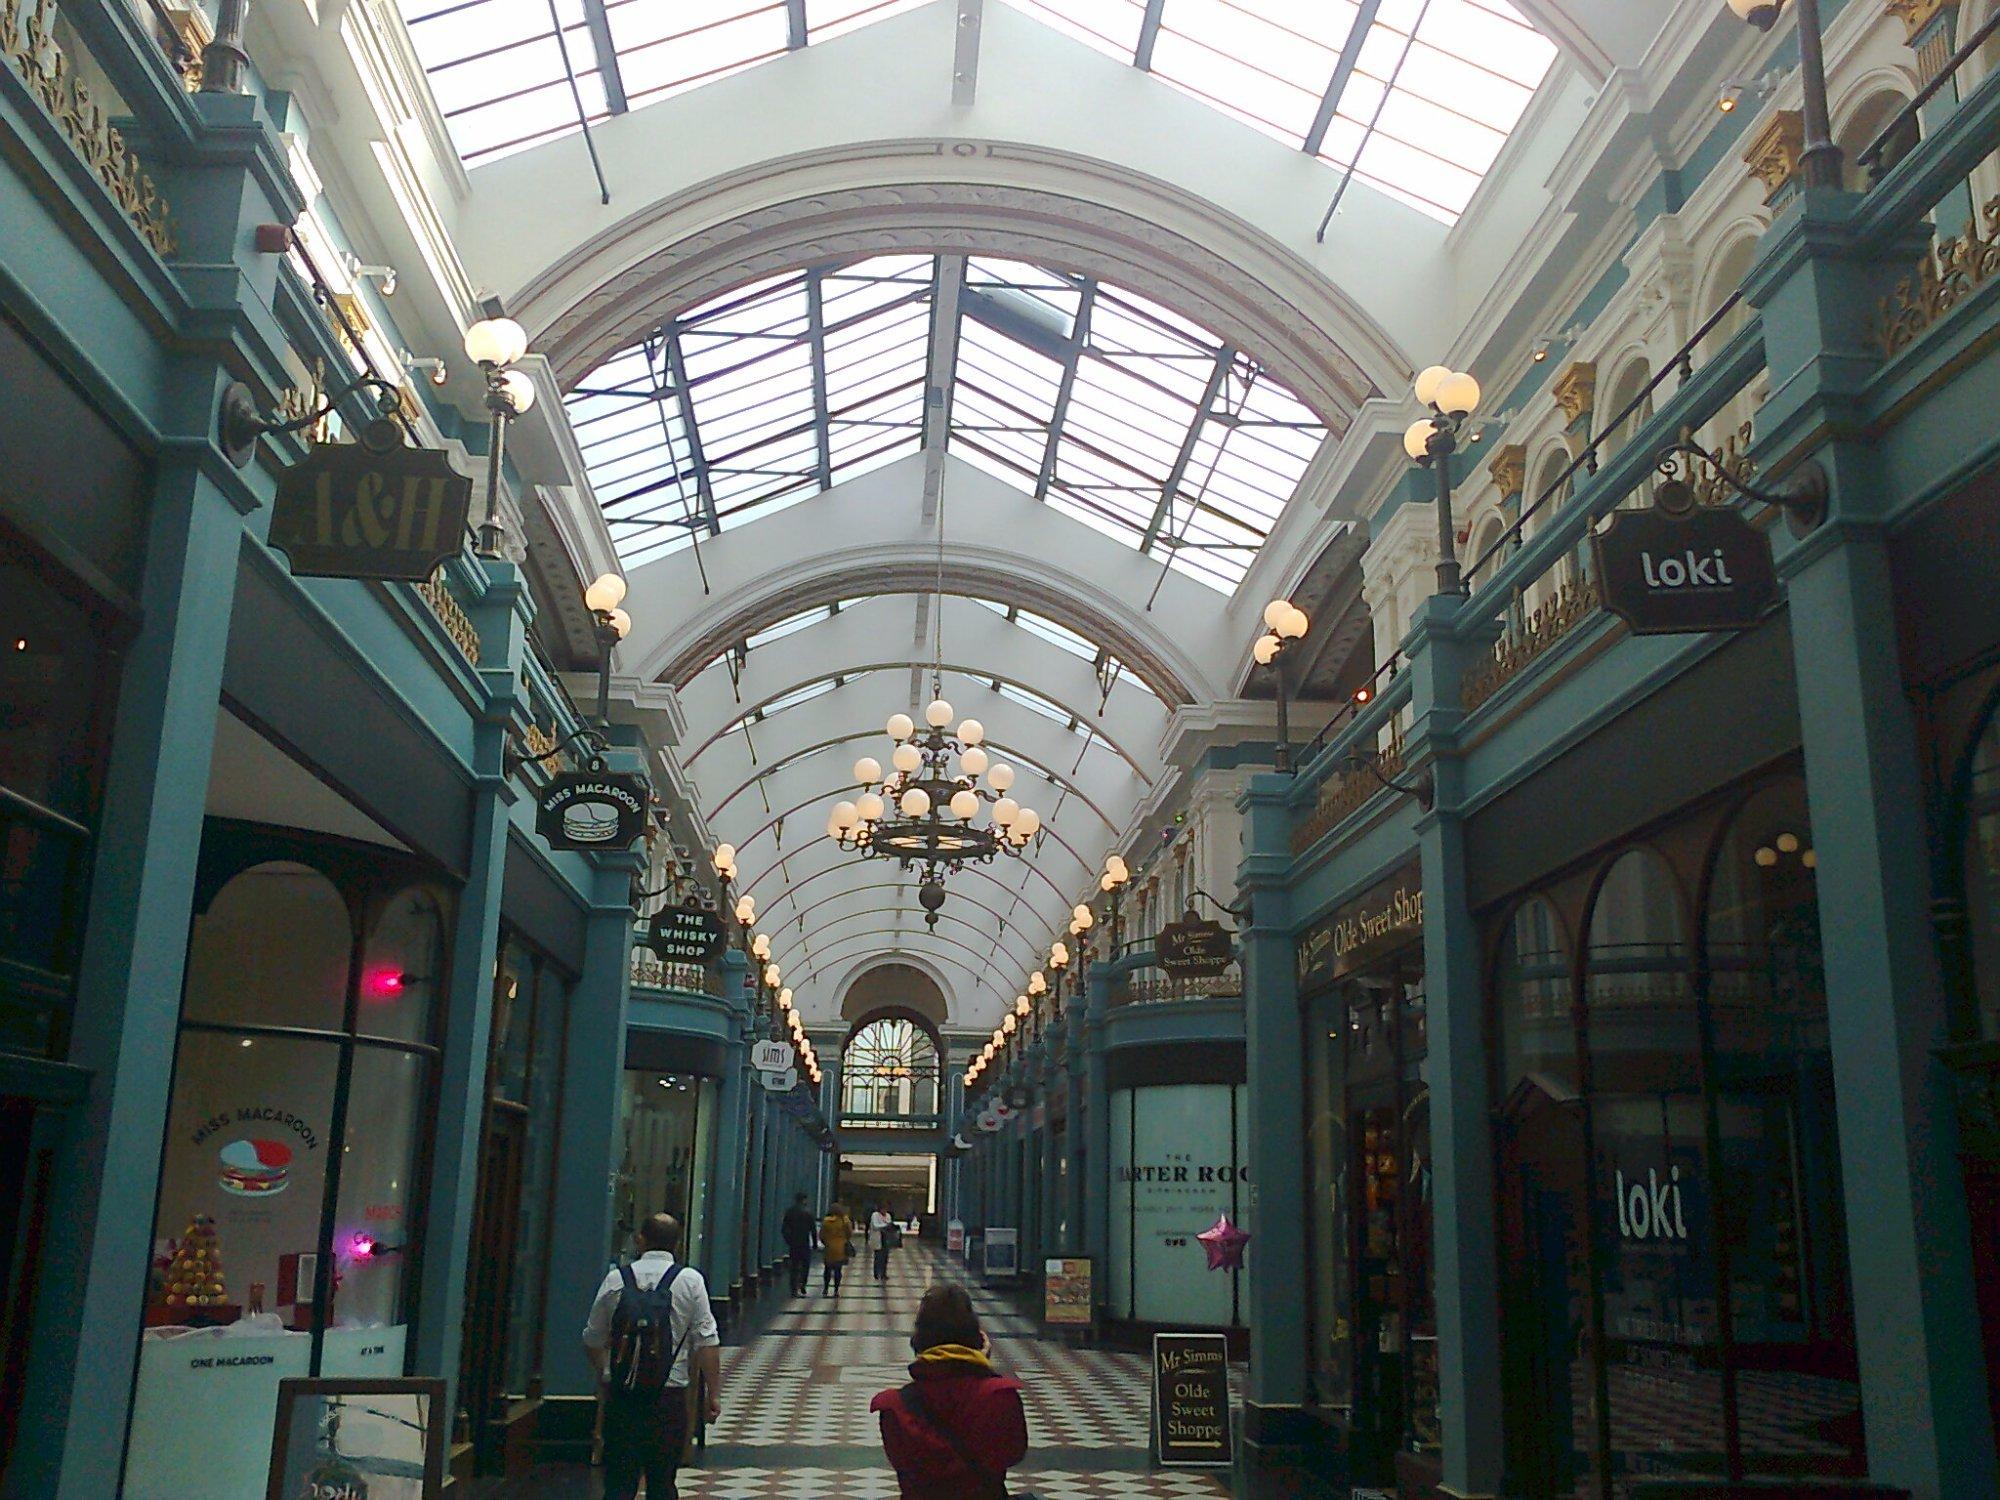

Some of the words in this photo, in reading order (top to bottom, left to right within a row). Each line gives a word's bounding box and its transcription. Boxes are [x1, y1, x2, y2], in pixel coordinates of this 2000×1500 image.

[1641, 548, 1733, 587] loki
[591, 760, 600, 770] 8
[543, 788, 572, 812] MISS
[575, 783, 642, 813] MACAROON
[676, 914, 704, 926] THE
[660, 928, 718, 943] WHISKY
[1335, 918, 1357, 956] Olde
[1360, 905, 1391, 944] Sweet
[667, 944, 705, 956] SHOP
[191, 1113, 230, 1145] MISS
[237, 1108, 318, 1150] MACAROON
[1615, 1165, 1687, 1239] loki
[191, 1358, 213, 1369] ONE
[216, 1355, 274, 1367] MACAROON
[1161, 1351, 1180, 1372] Mr
[1183, 1348, 1223, 1365] Simms
[1175, 1383, 1211, 1398] Olde
[1172, 1401, 1215, 1417] Sweet
[1168, 1420, 1222, 1439] Shoppe
